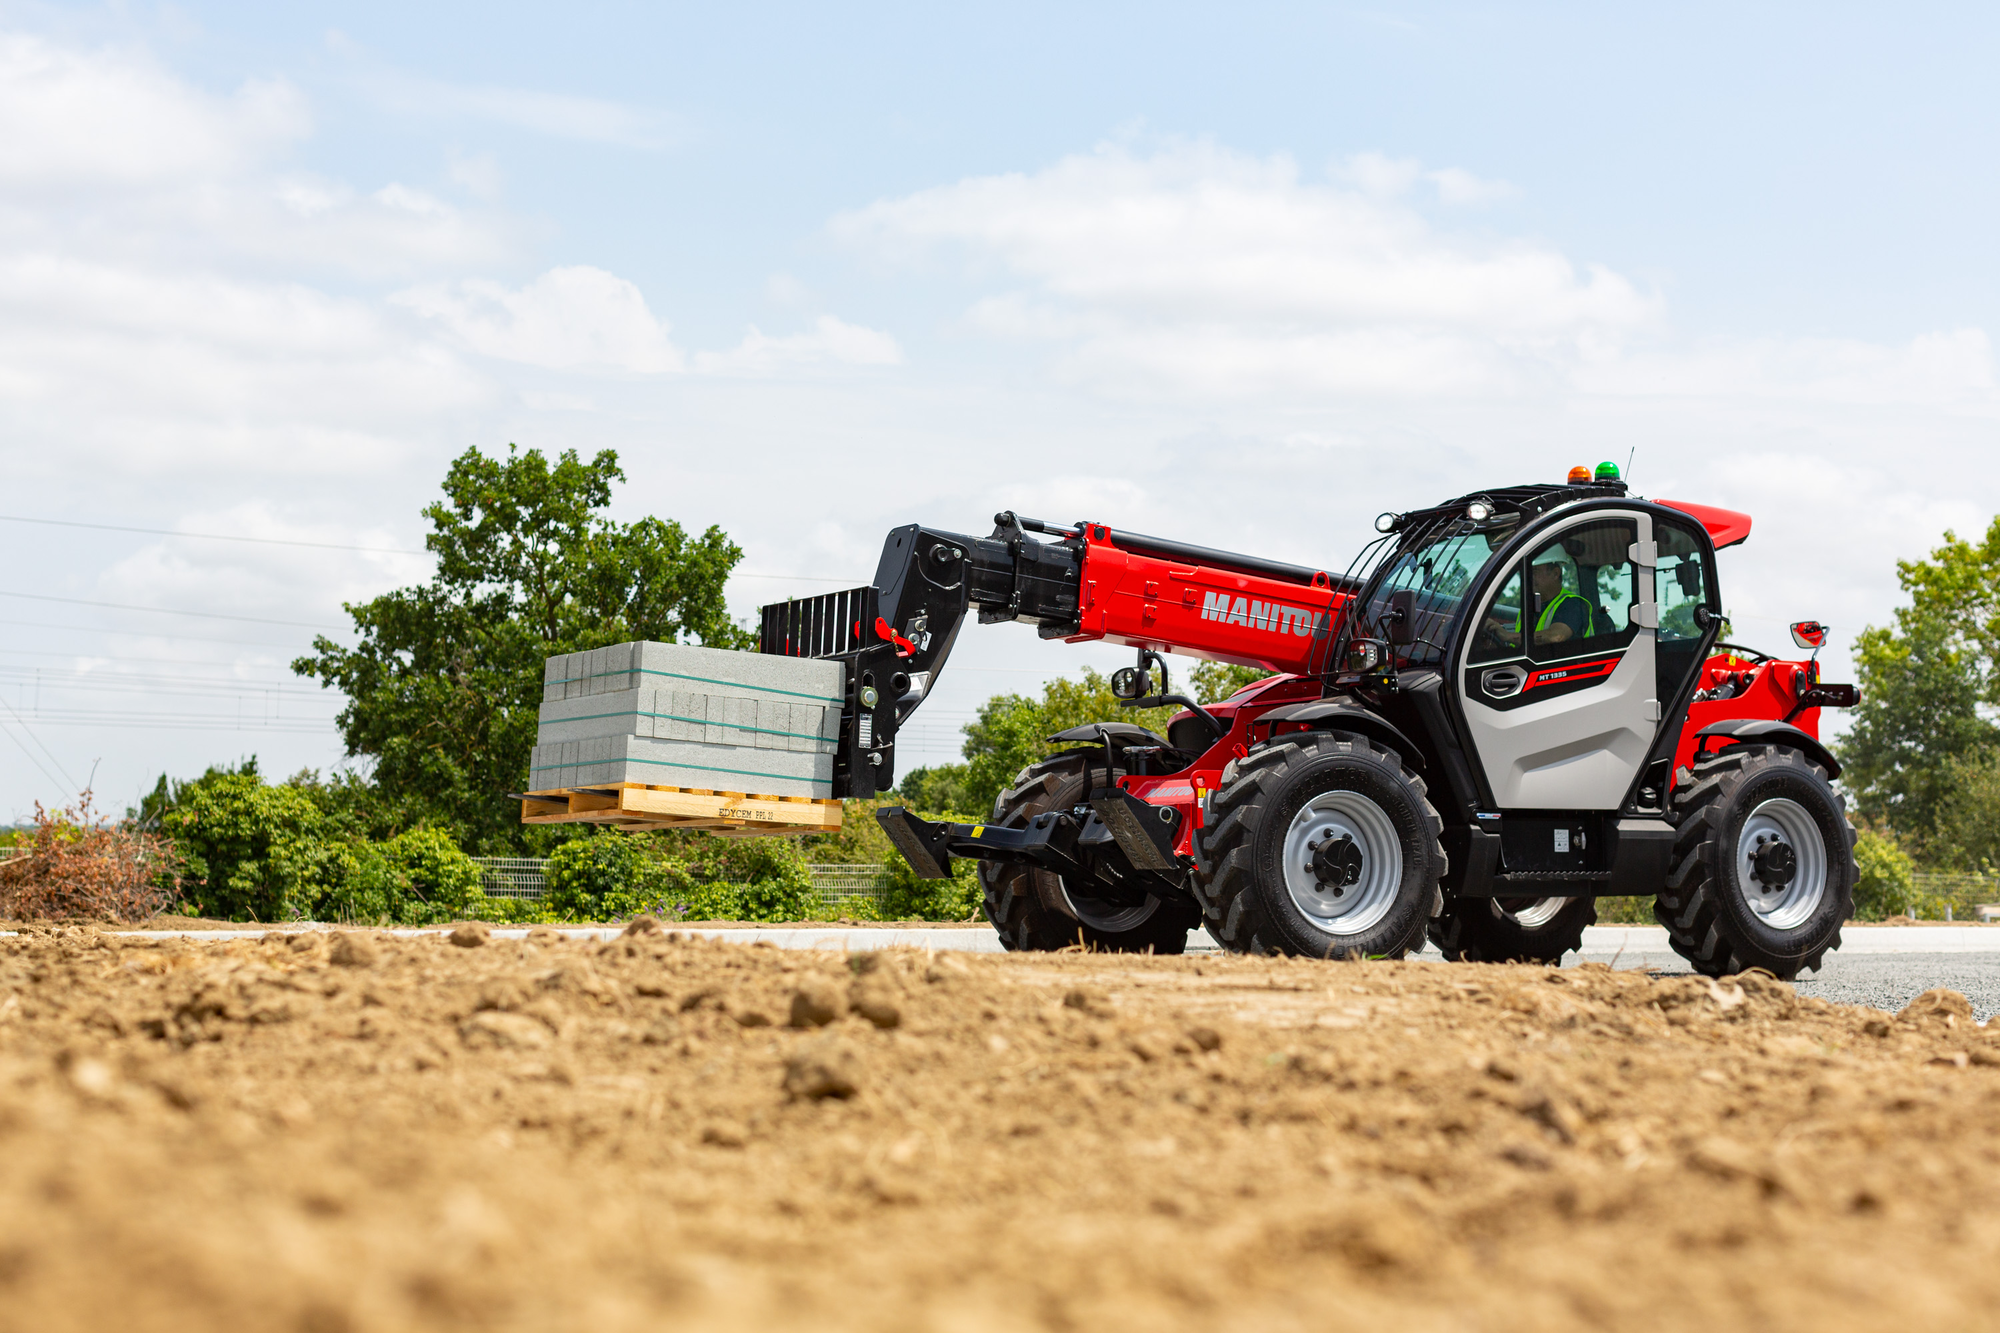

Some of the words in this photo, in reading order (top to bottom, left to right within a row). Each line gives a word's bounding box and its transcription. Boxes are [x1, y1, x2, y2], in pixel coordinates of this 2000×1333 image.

[1201, 591, 1331, 640] MANITOU
[1550, 671, 1567, 679] 1335
[1144, 786, 1194, 799] MANITOU
[718, 807, 752, 819] EDYCEM
